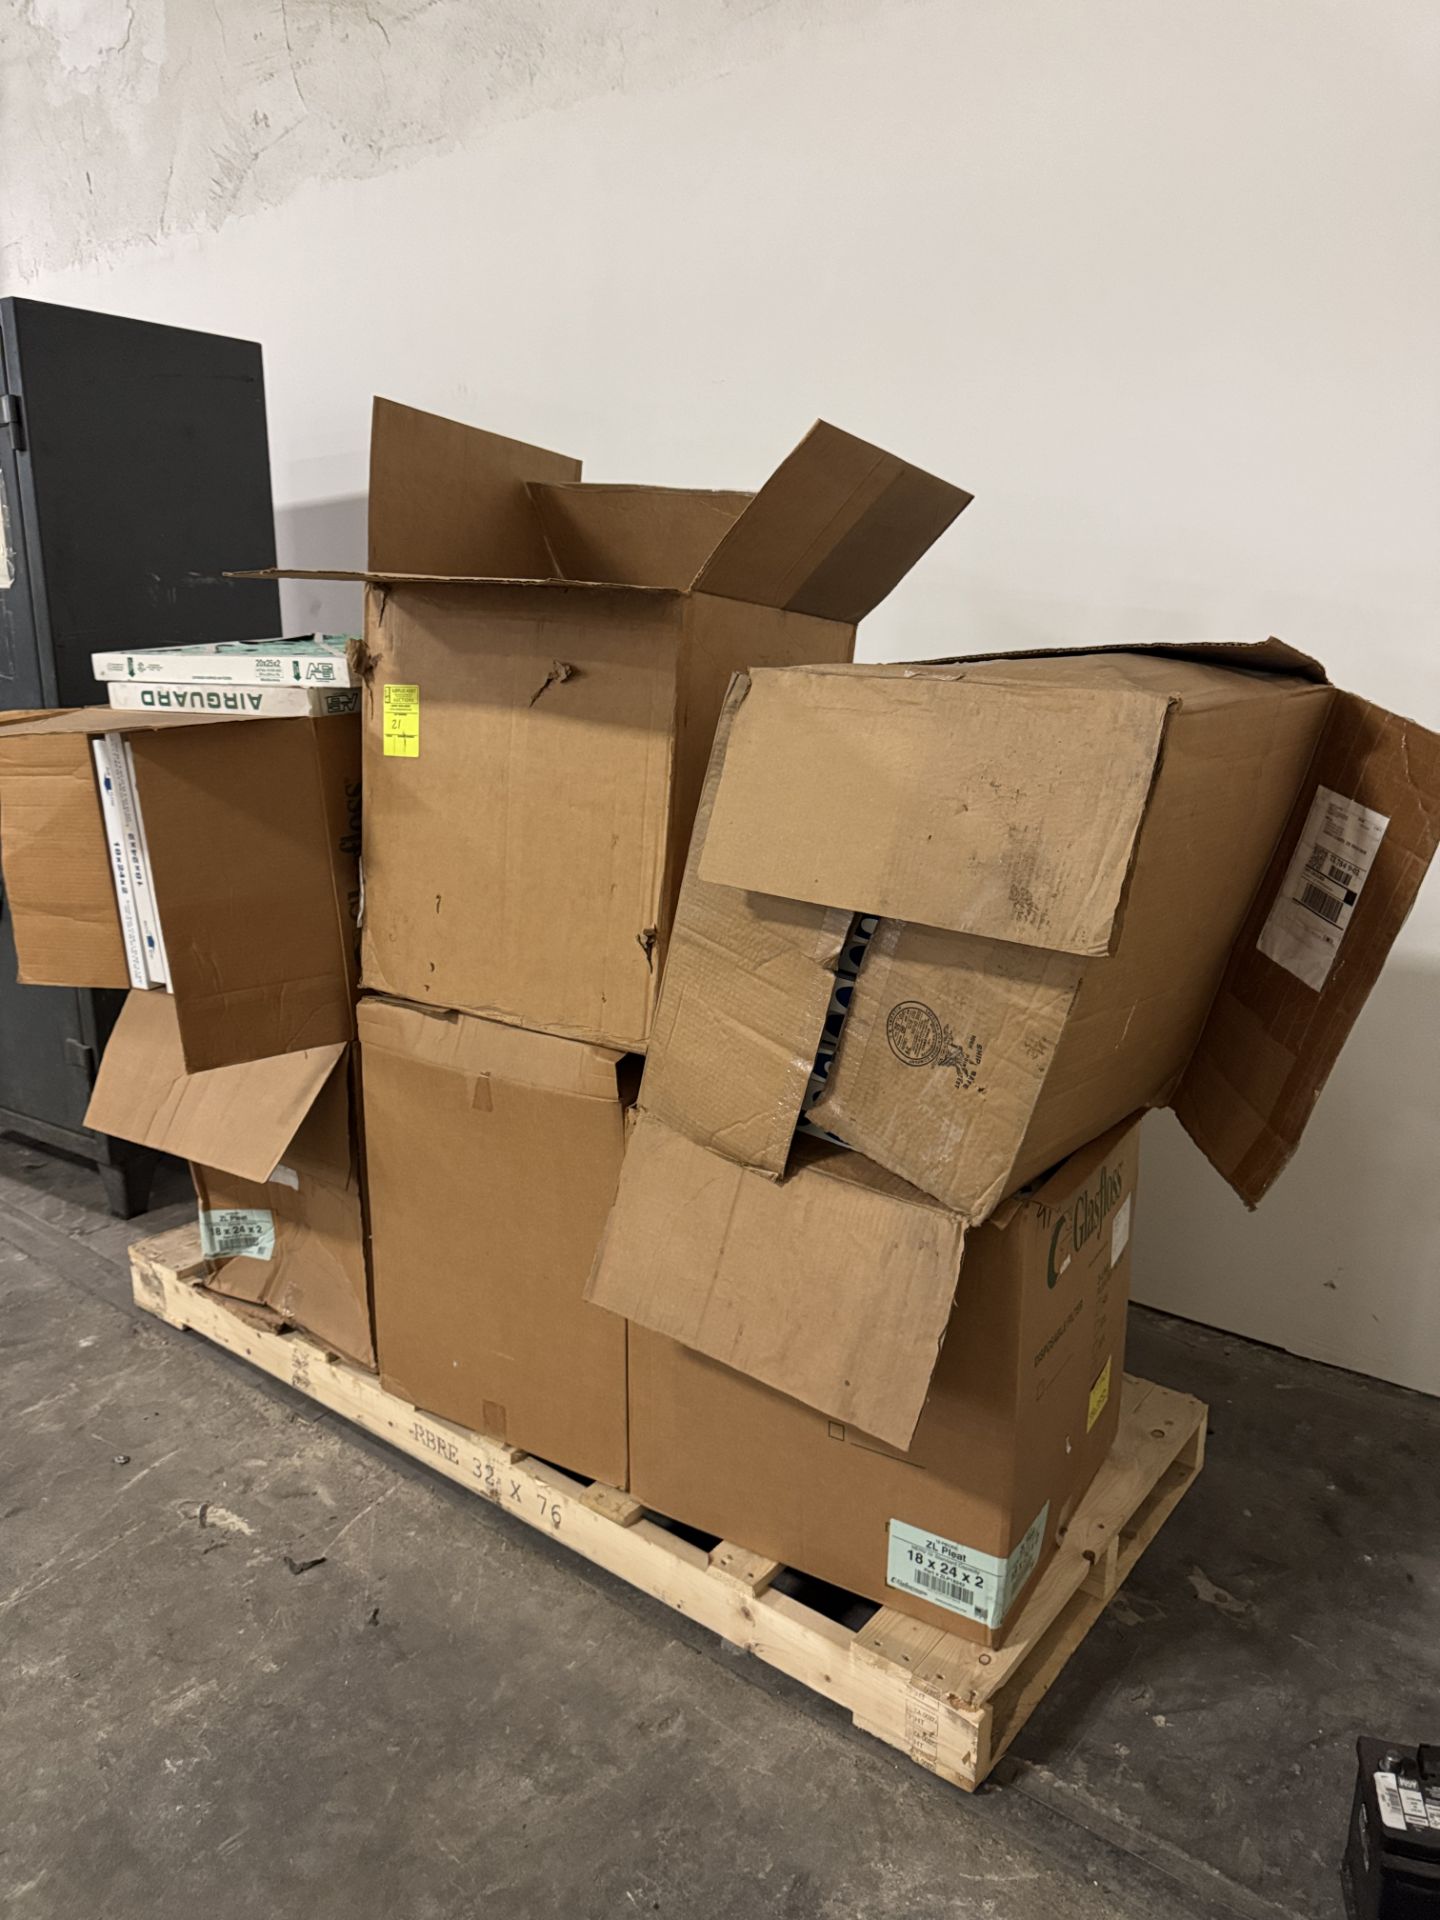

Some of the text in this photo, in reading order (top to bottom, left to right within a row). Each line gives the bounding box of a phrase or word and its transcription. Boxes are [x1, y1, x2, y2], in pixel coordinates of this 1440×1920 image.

[140, 690, 263, 711] AIRGUARD
[1073, 1165, 1122, 1253] Glasfloss
[536, 1493, 562, 1530] 76
[906, 1549, 924, 1566] 18
[927, 1558, 936, 1570] x
[940, 1562, 958, 1578] 24
[961, 1572, 971, 1585] x
[974, 1575, 985, 1590] 2
[925, 1539, 939, 1553] ZL
[941, 1546, 967, 1563] Pleat
